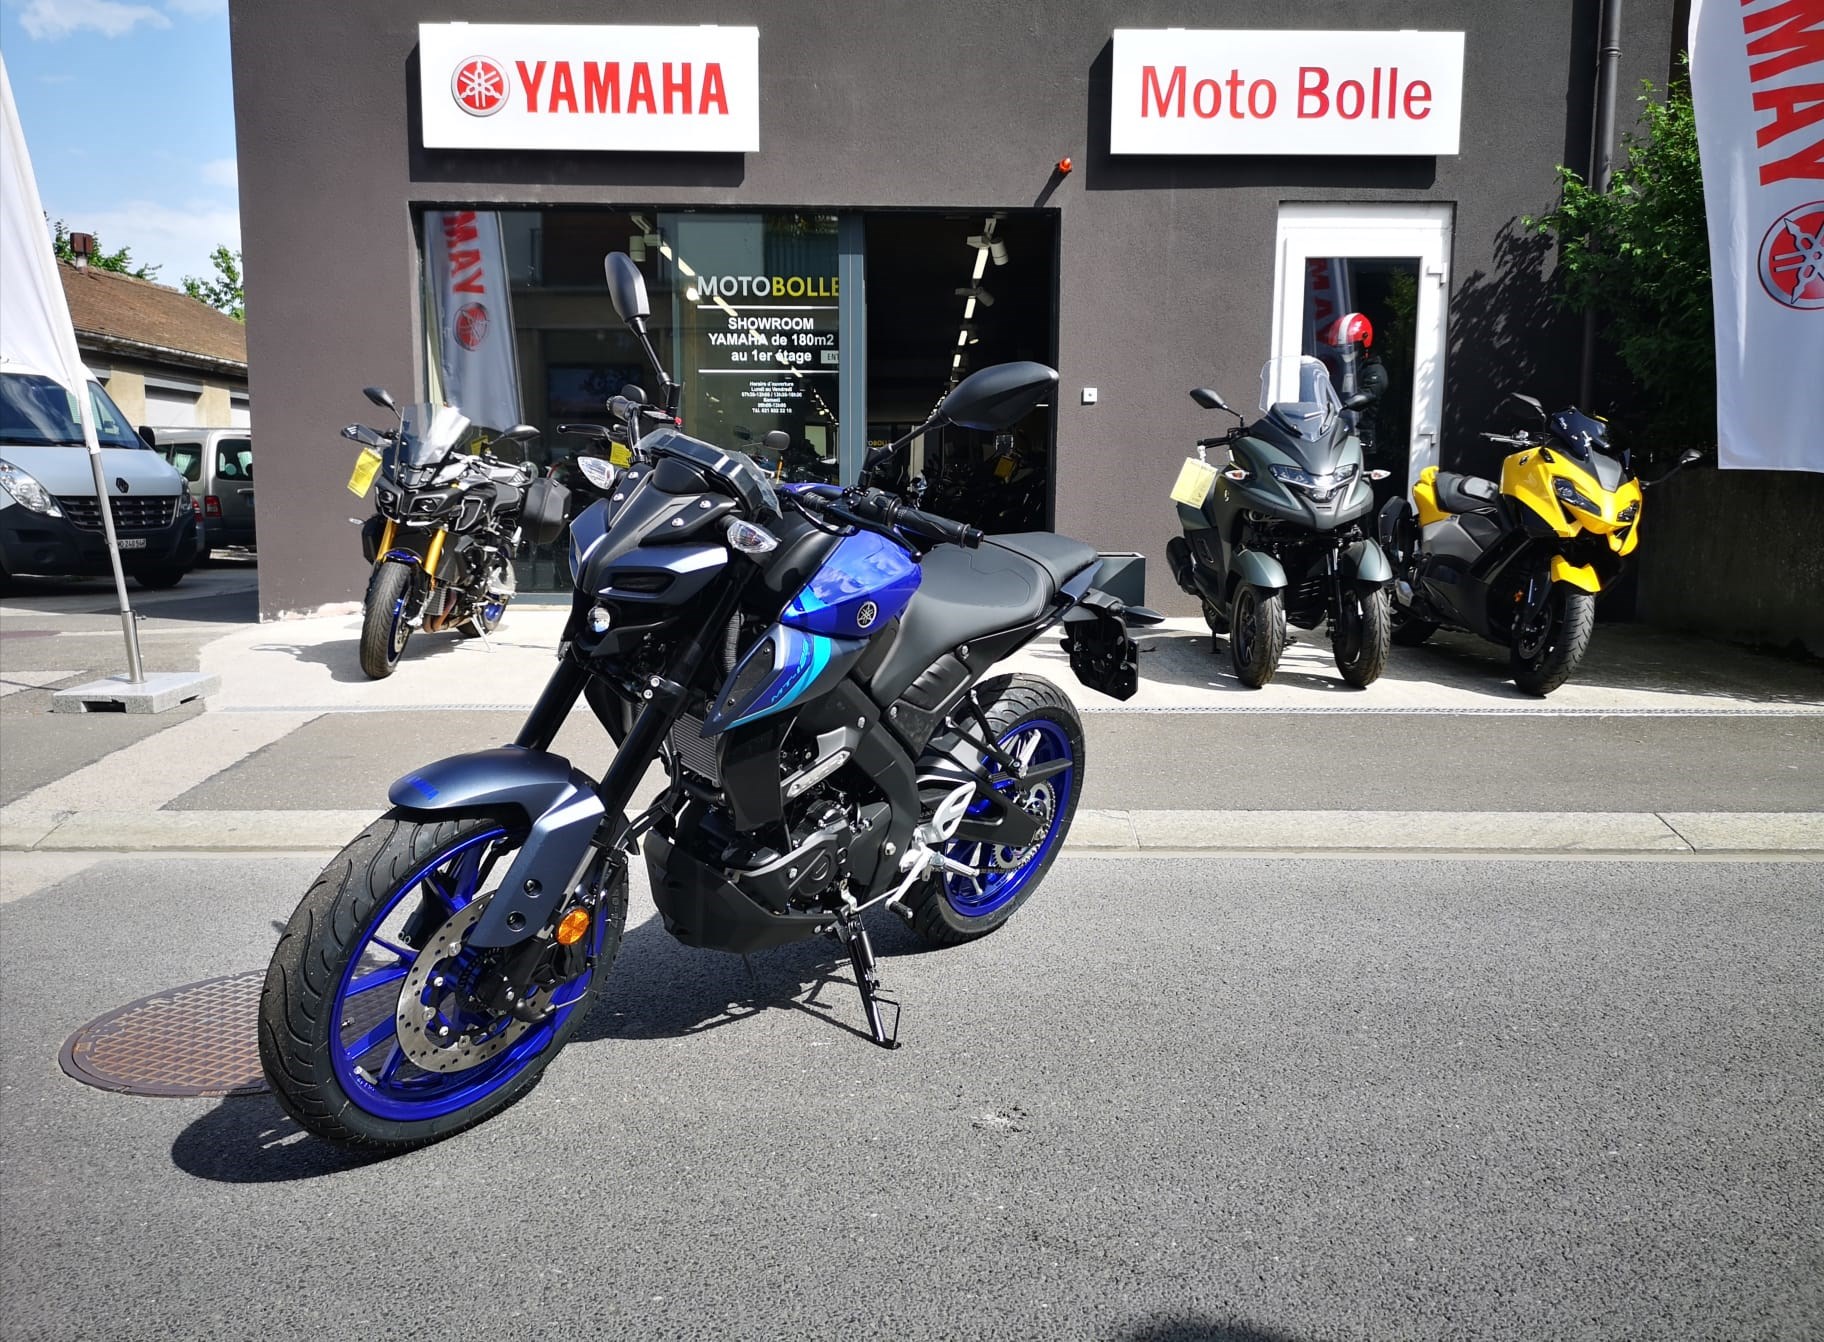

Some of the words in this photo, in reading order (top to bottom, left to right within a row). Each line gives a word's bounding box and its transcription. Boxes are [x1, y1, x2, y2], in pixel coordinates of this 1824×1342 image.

[515, 60, 729, 115] YAMAHA
[1141, 65, 1277, 119] Moto
[1297, 66, 1432, 120] Bolle
[697, 275, 839, 297] MOTOBOLLE
[728, 317, 814, 330] SHOWROOM
[708, 333, 768, 346] YAMAHA
[771, 333, 788, 346] de
[791, 334, 834, 346] 180m2
[731, 352, 748, 362] au
[752, 349, 772, 362] 1er
[775, 349, 812, 365] étage
